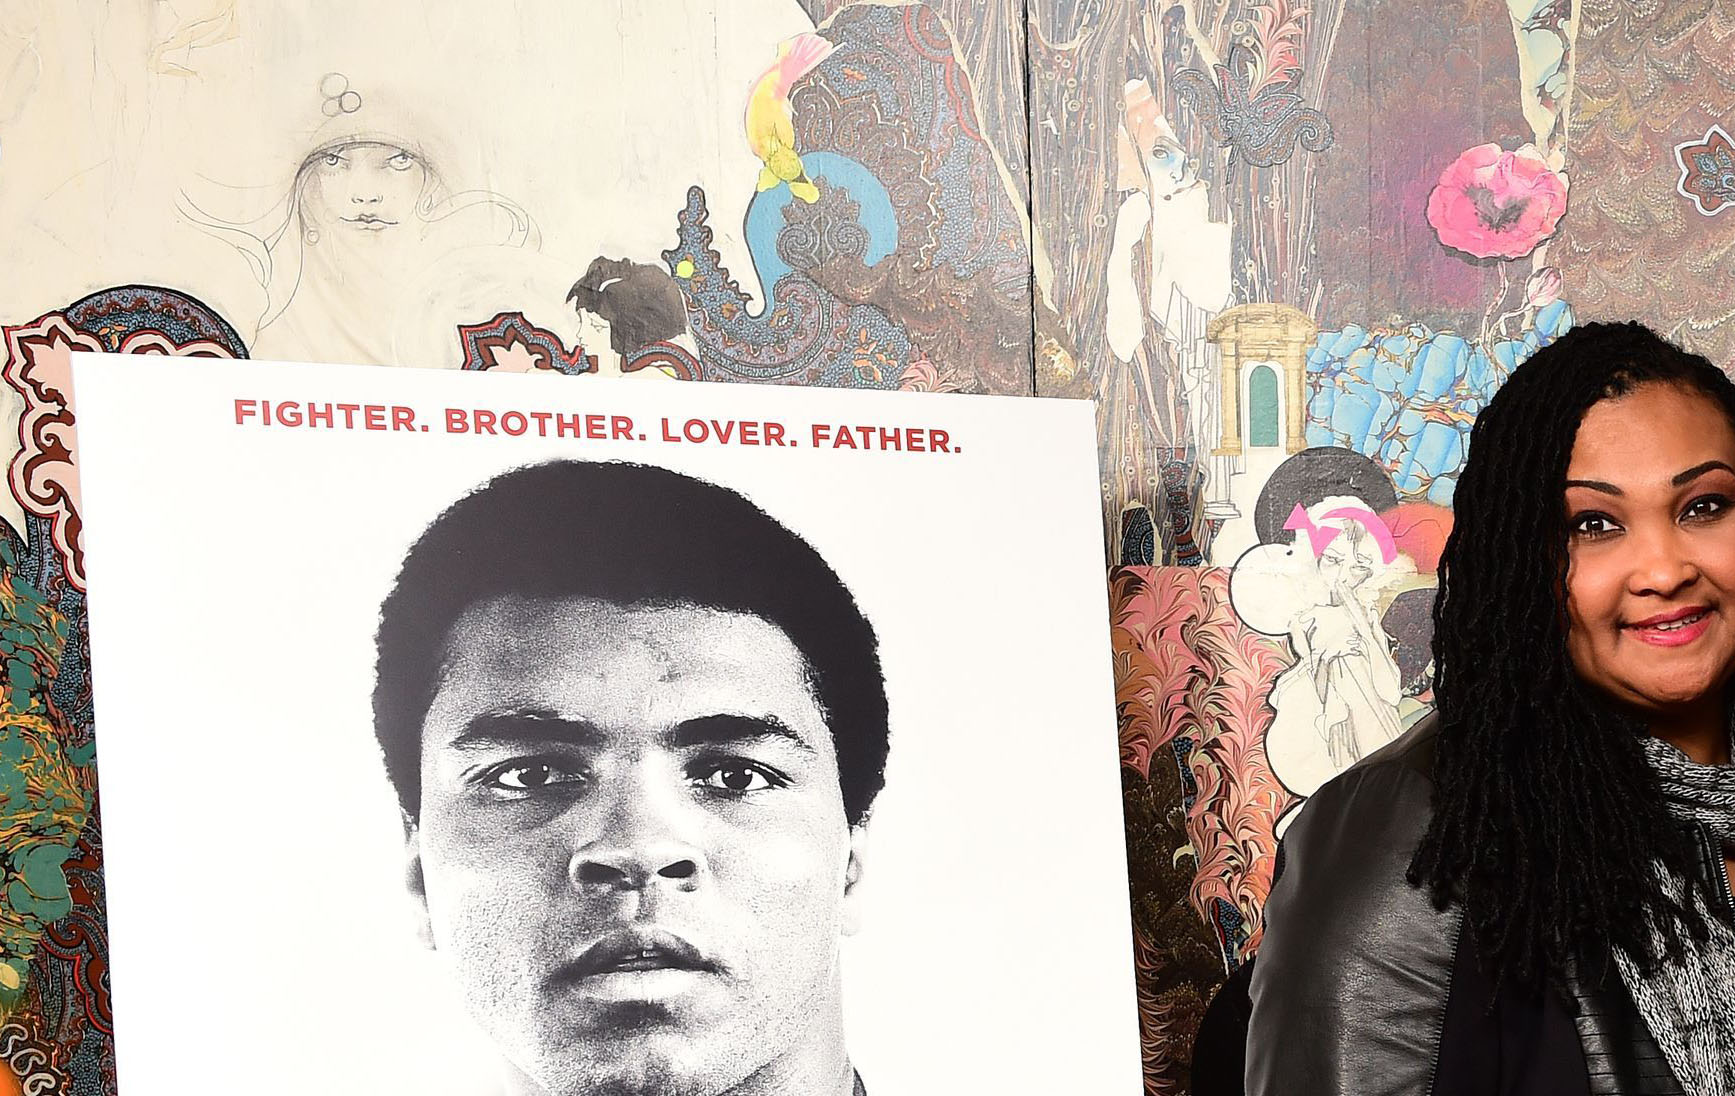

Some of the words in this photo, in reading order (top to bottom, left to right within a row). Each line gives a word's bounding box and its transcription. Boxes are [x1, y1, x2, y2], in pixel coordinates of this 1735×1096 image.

[234, 399, 429, 432] FIGHTER.
[444, 408, 646, 441] BROTHER.
[661, 417, 798, 447] LOVER.
[812, 424, 963, 454] FATHER.
